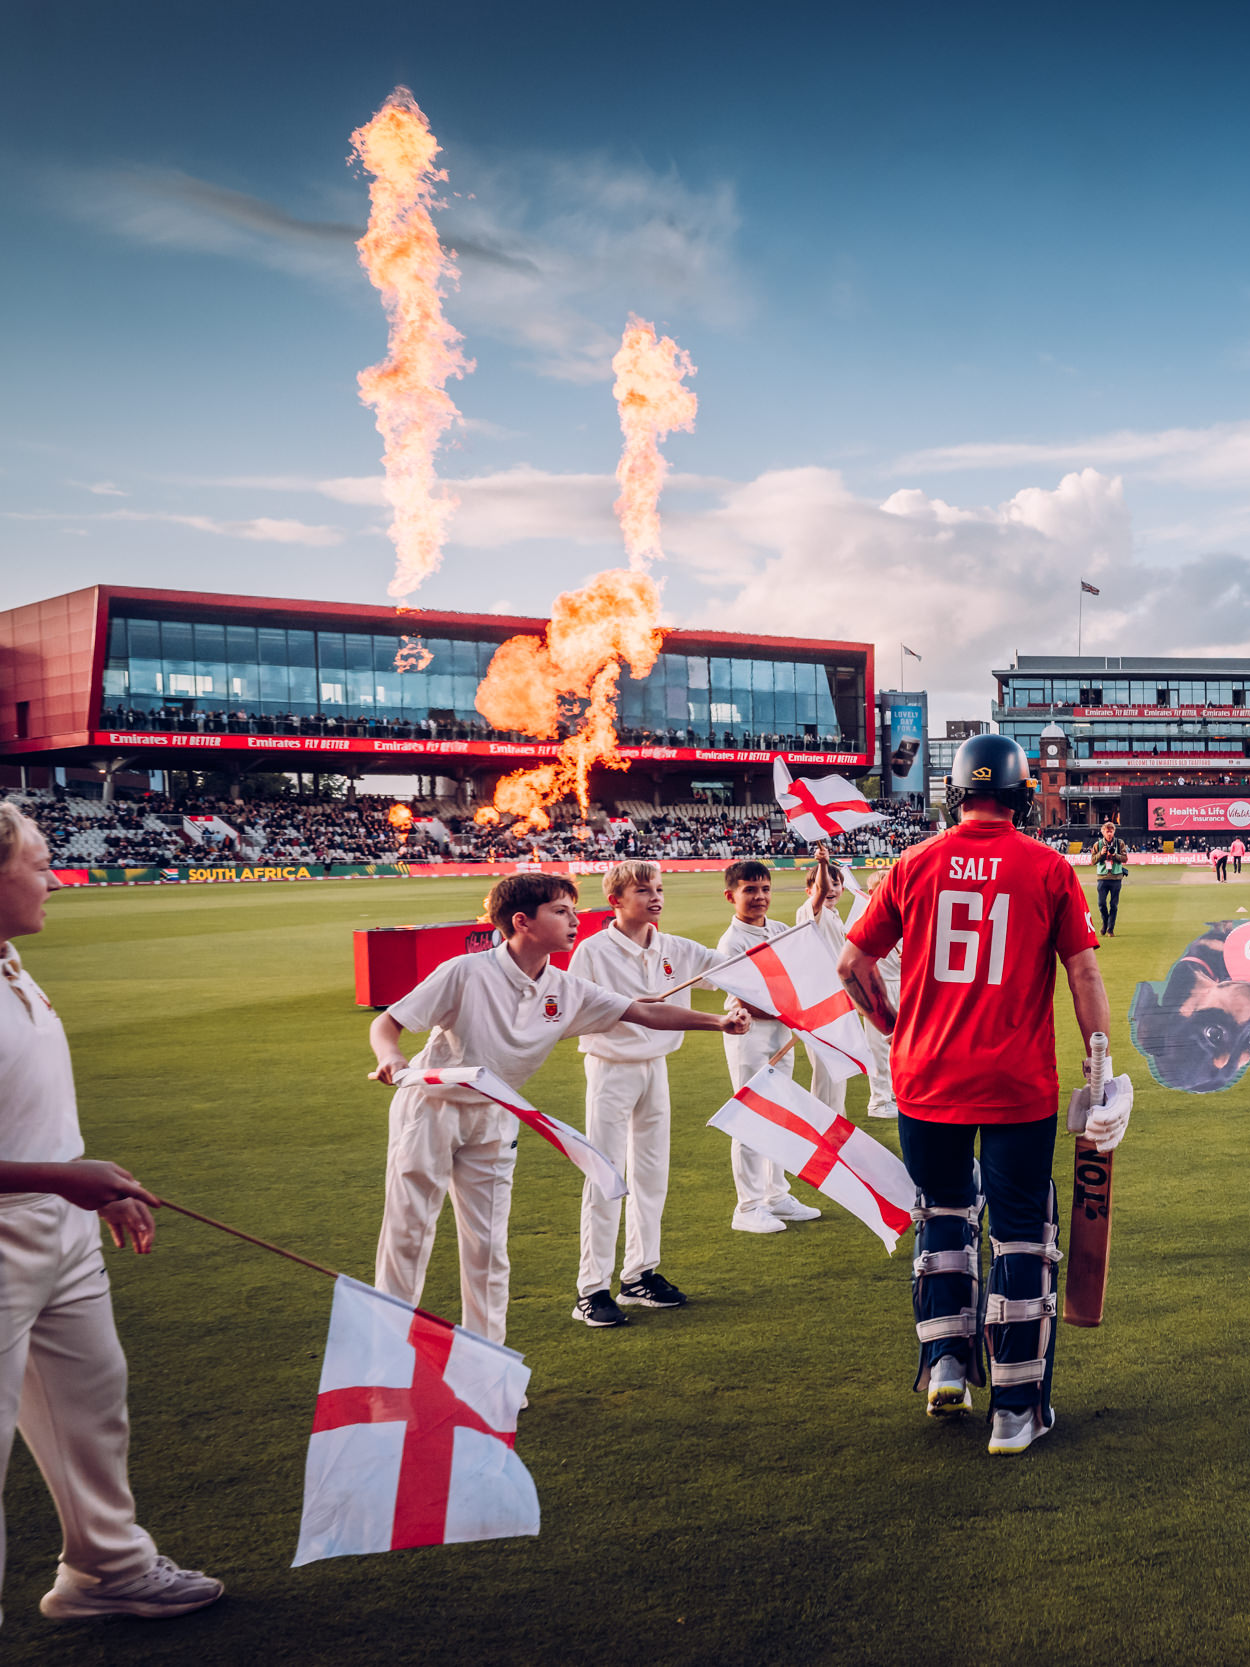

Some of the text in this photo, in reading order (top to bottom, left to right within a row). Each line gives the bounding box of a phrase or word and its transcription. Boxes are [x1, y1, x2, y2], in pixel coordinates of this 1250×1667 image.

[1202, 709, 1230, 717] Emirates
[110, 733, 221, 747] Emirates FLY BETTER
[248, 737, 350, 750] Emirates FLY BETTER
[374, 741, 424, 752] Emirates
[696, 750, 771, 761] Emirates FLY BETTER
[788, 753, 857, 764] Emirates FLY BETTER
[1169, 807, 1198, 815] Health
[1208, 807, 1225, 815] Life
[865, 858, 901, 867] SOU
[1151, 855, 1179, 864] Health
[1180, 855, 1192, 863] and
[1193, 854, 1208, 863] Lif
[189, 867, 311, 880] SOUTH AFRICA
[949, 856, 1002, 881] SALT
[933, 890, 1010, 985] 61
